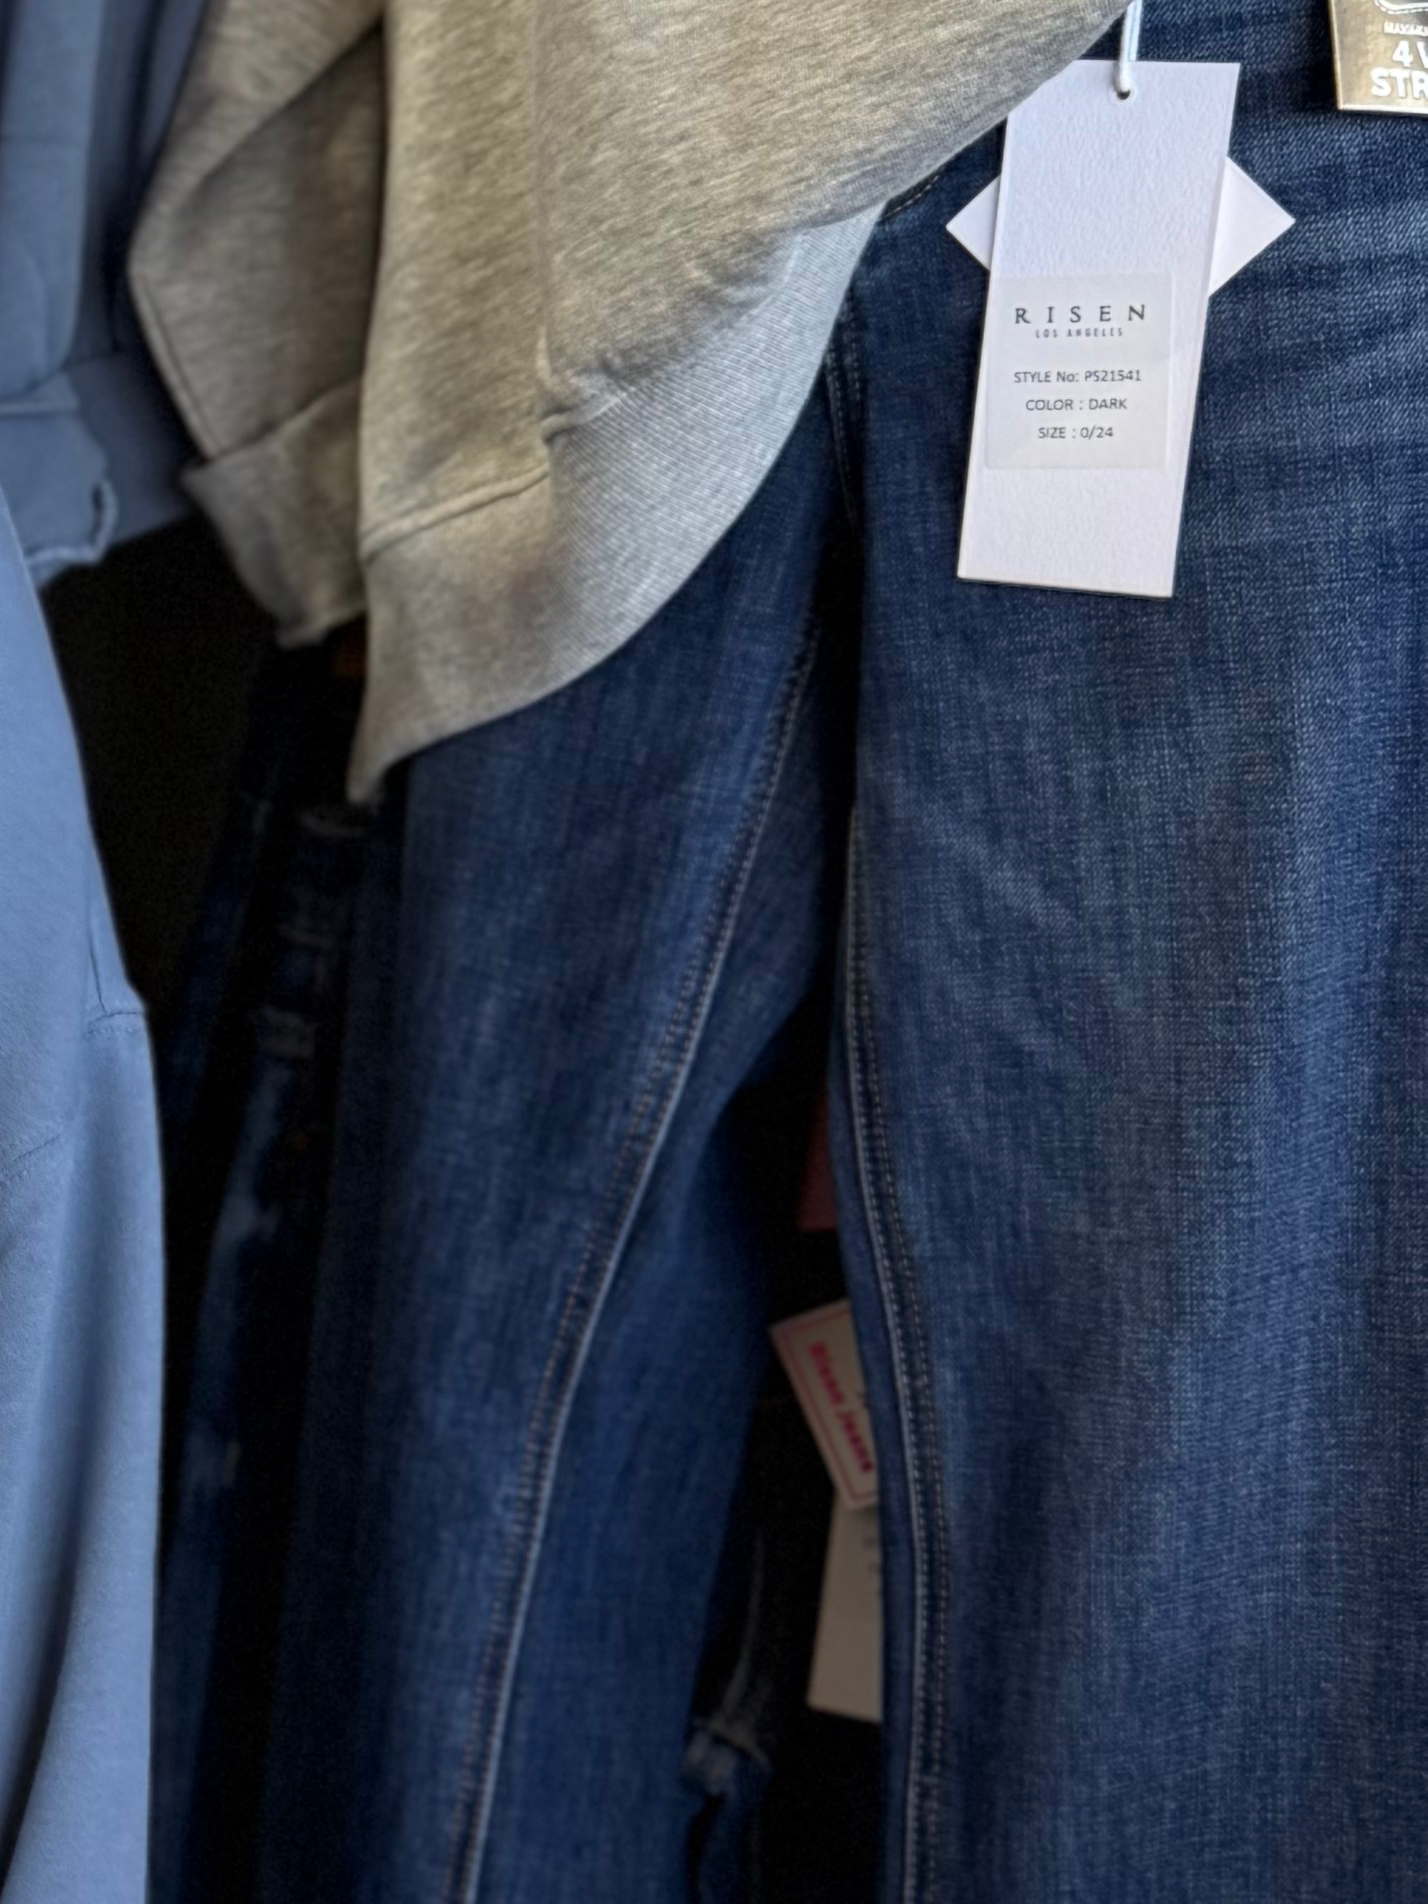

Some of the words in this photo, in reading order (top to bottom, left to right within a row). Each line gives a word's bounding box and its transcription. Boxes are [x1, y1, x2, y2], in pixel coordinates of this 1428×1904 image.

[1392, 40, 1414, 68] 4
[1015, 304, 1146, 324] RISEN
[1035, 328, 1059, 339] LOS
[1066, 327, 1124, 338] ANGELES
[1013, 370, 1052, 384] STYLE
[1056, 370, 1080, 383] No:
[1084, 369, 1142, 383] PS21541
[1025, 398, 1074, 412] COLOR
[1088, 398, 1128, 411] DARK
[1037, 426, 1067, 440] SIZE
[1079, 425, 1115, 441] 0/24
